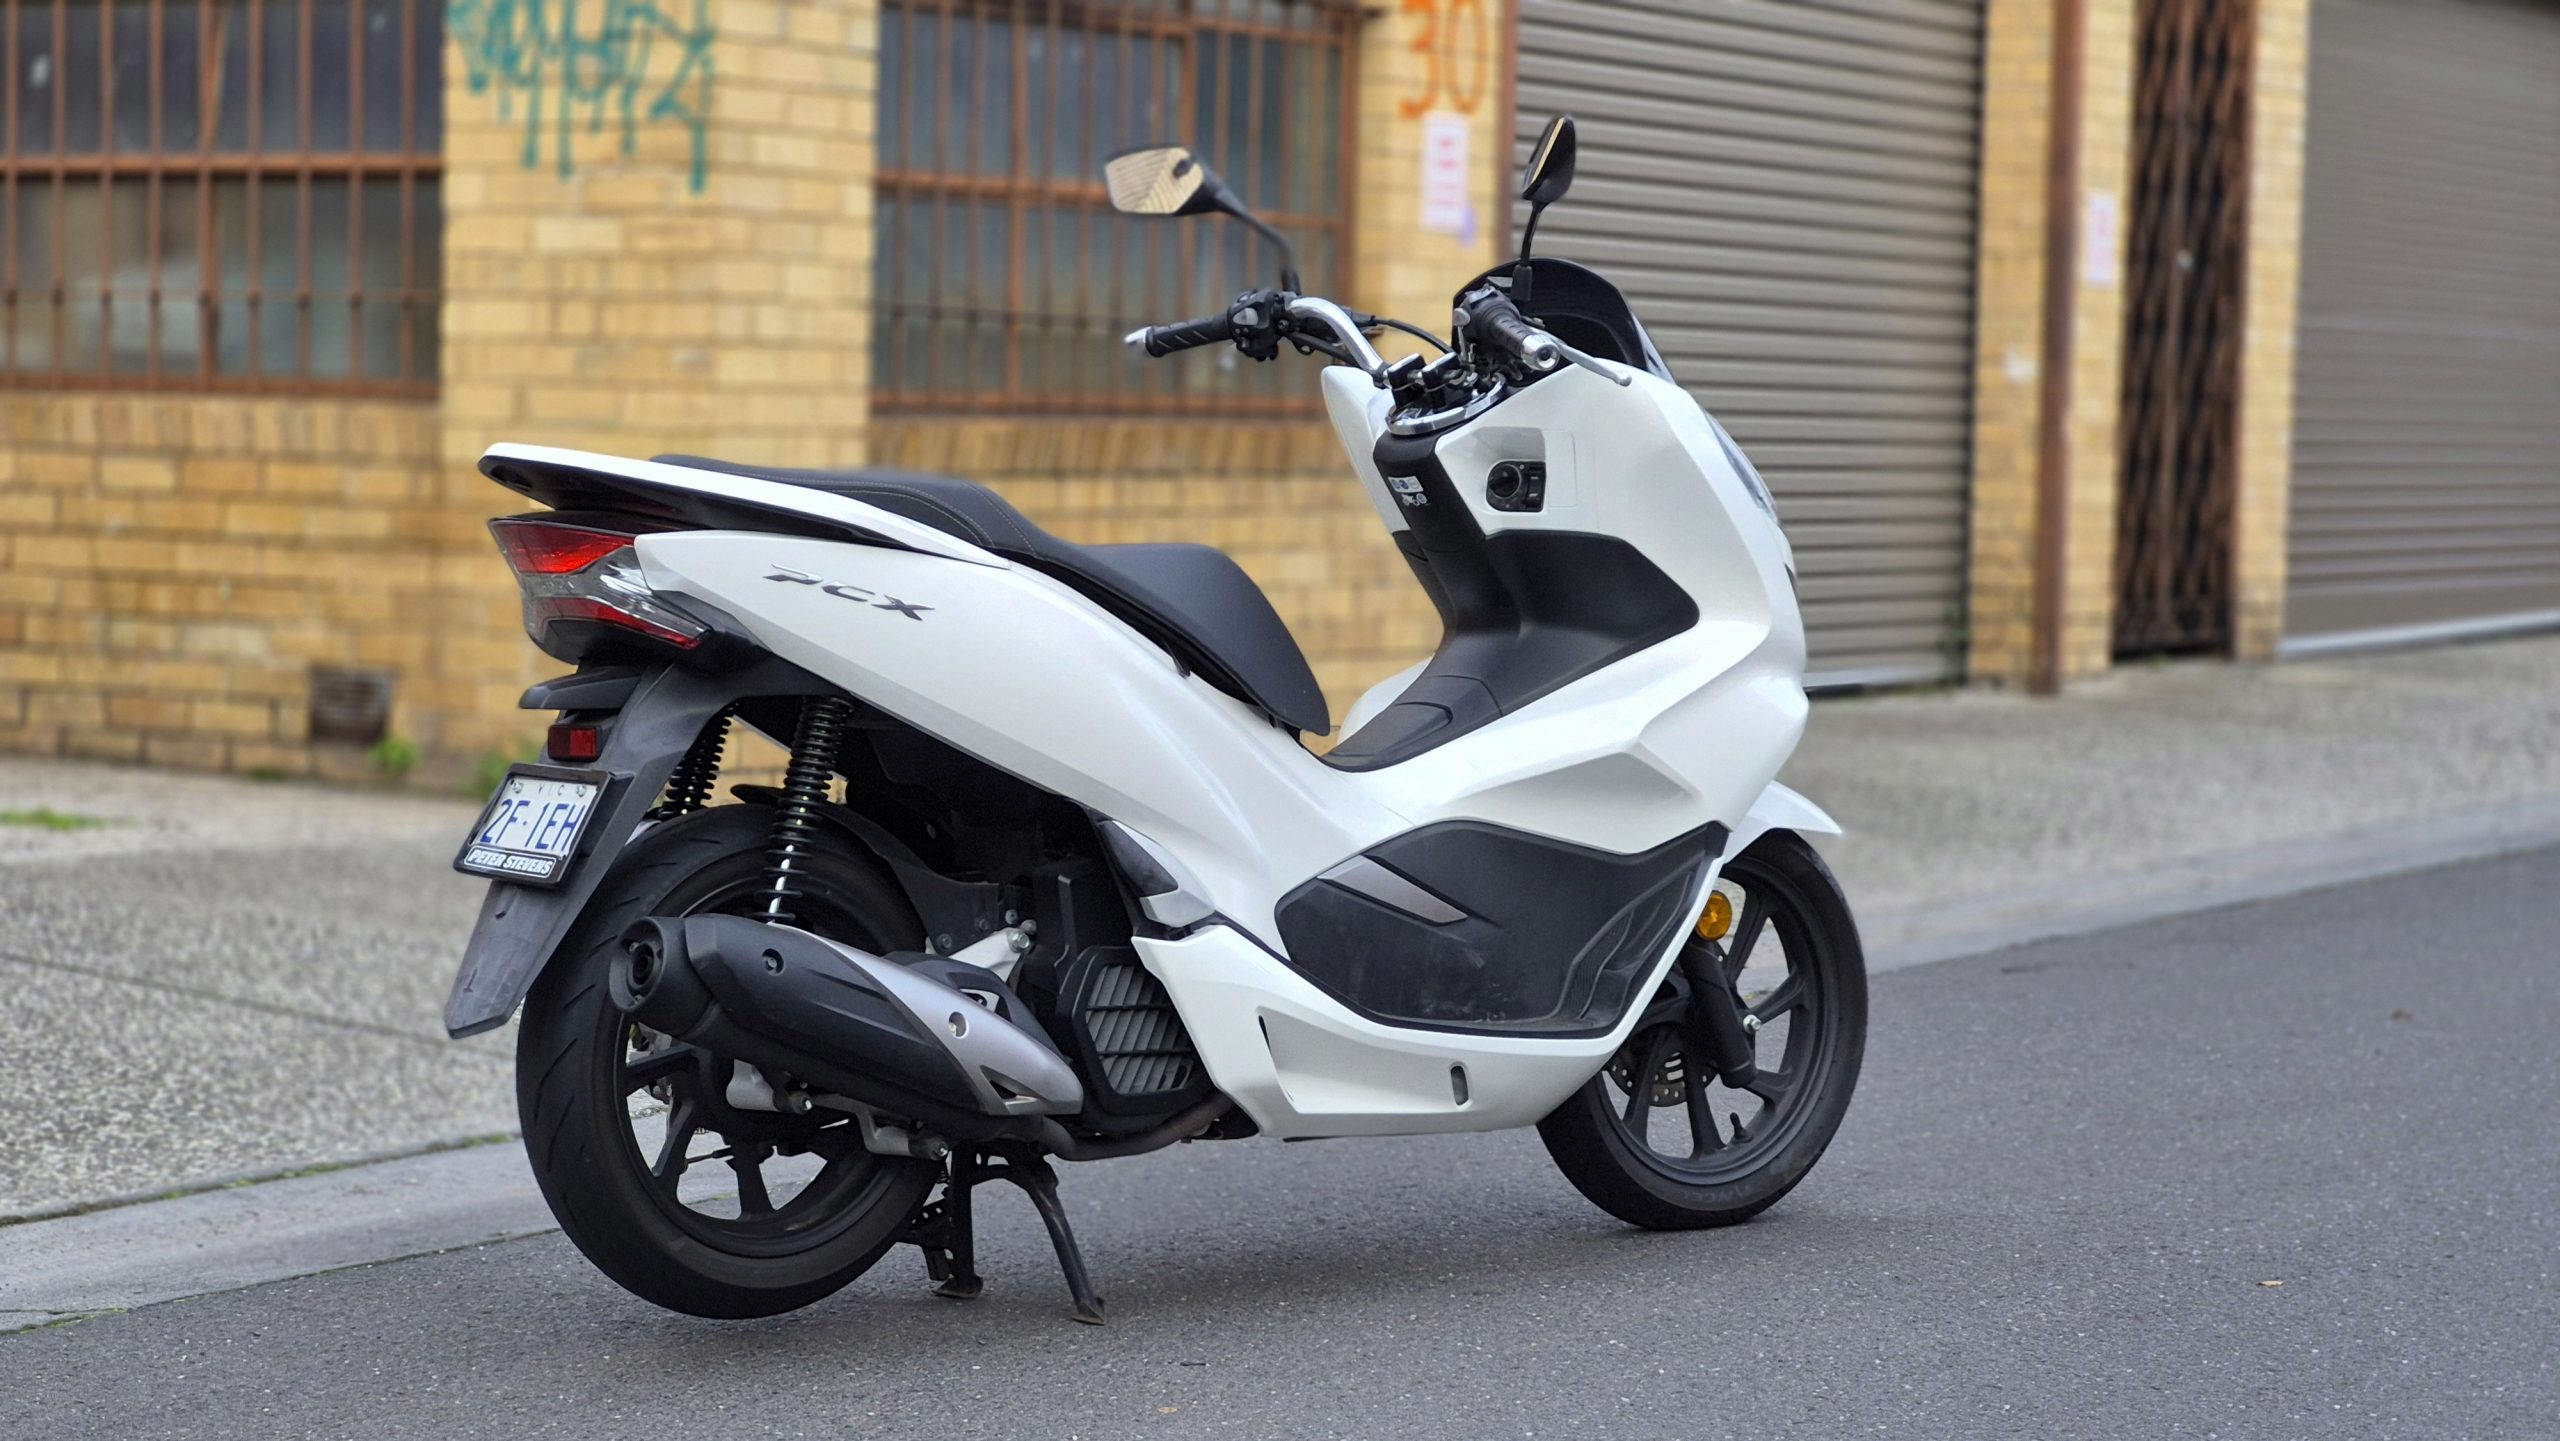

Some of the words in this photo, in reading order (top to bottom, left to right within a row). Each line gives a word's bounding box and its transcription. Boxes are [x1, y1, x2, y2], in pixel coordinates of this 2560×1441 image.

[1397, 0, 1489, 119] 30
[763, 563, 936, 622] PCX
[467, 848, 507, 868] PETER
[502, 855, 554, 875] STEVENS
